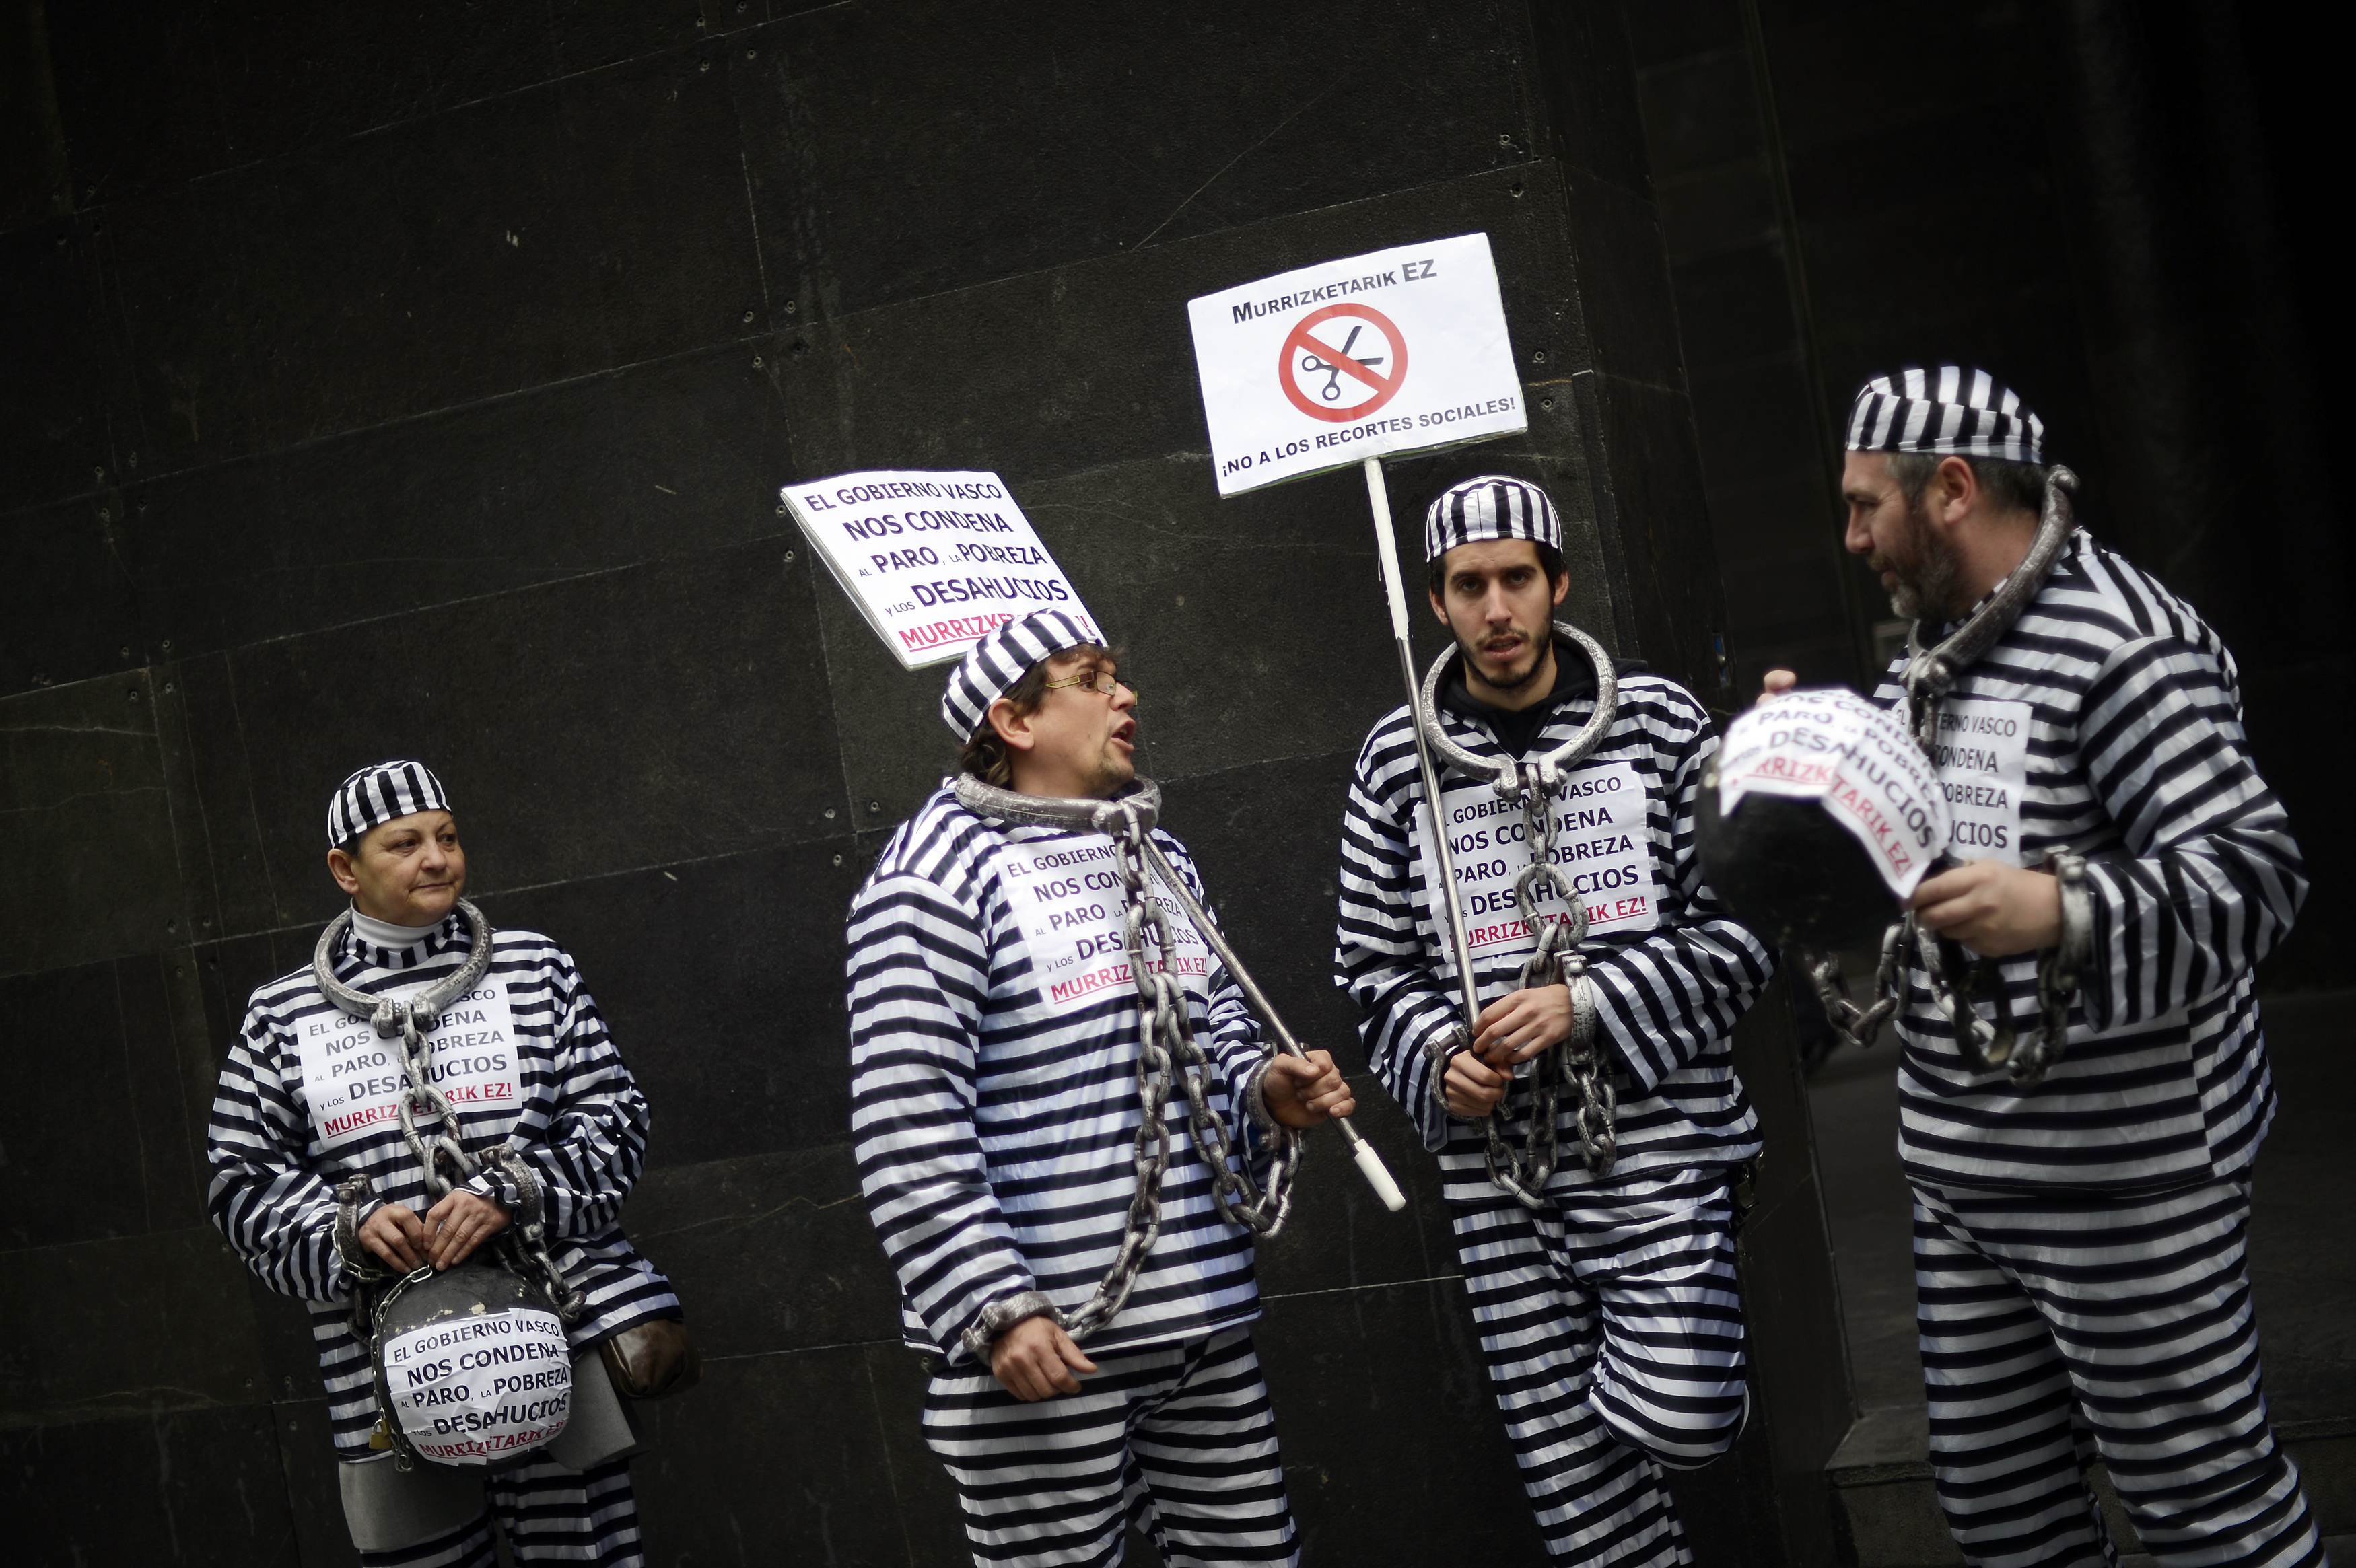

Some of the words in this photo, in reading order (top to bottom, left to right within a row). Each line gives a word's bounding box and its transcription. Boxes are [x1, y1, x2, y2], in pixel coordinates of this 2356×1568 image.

[1232, 271, 1397, 324] MURRIZKETARIK
[1401, 258, 1437, 282] EZ
[1222, 455, 1253, 477] ¡NO
[1259, 451, 1271, 465] A
[1275, 439, 1310, 460] LOS
[1315, 416, 1413, 449] RECORTES
[1418, 397, 1516, 427] SOCIALES!
[804, 495, 837, 512] EL
[836, 481, 940, 505] GOBIERNO
[941, 483, 1002, 500] VASCO
[842, 513, 904, 542] NOS
[904, 510, 1014, 532] CONDENA
[858, 566, 872, 578] AL
[948, 554, 962, 564] LA
[955, 543, 1048, 565] POBREZA
[893, 601, 916, 614] LOS
[911, 577, 1069, 608] DESAHUCIOS
[1971, 715, 2017, 737] VASCO
[1007, 863, 1031, 878] EL
[1032, 878, 1081, 902] NOS
[1616, 896, 1647, 917] EZ!
[1035, 927, 1046, 936] AL
[1113, 909, 1123, 917] LA
[1055, 956, 1074, 968] LOS
[309, 1024, 330, 1036] EL
[326, 1031, 370, 1056] NOS
[327, 1096, 345, 1107] LOS
[349, 1054, 507, 1100] DESAUCIOS
[484, 1082, 512, 1098] EZ!
[394, 1346, 411, 1363] EL
[415, 1320, 511, 1354] GOBIERNO
[515, 1320, 559, 1337] VASCO
[407, 1359, 453, 1388] NOS
[459, 1343, 559, 1371] CONDENA
[401, 1400, 409, 1409] AL
[481, 1390, 491, 1398] LA
[493, 1367, 567, 1395] POBREZA
[433, 1393, 566, 1435] DESAHUCIOS
